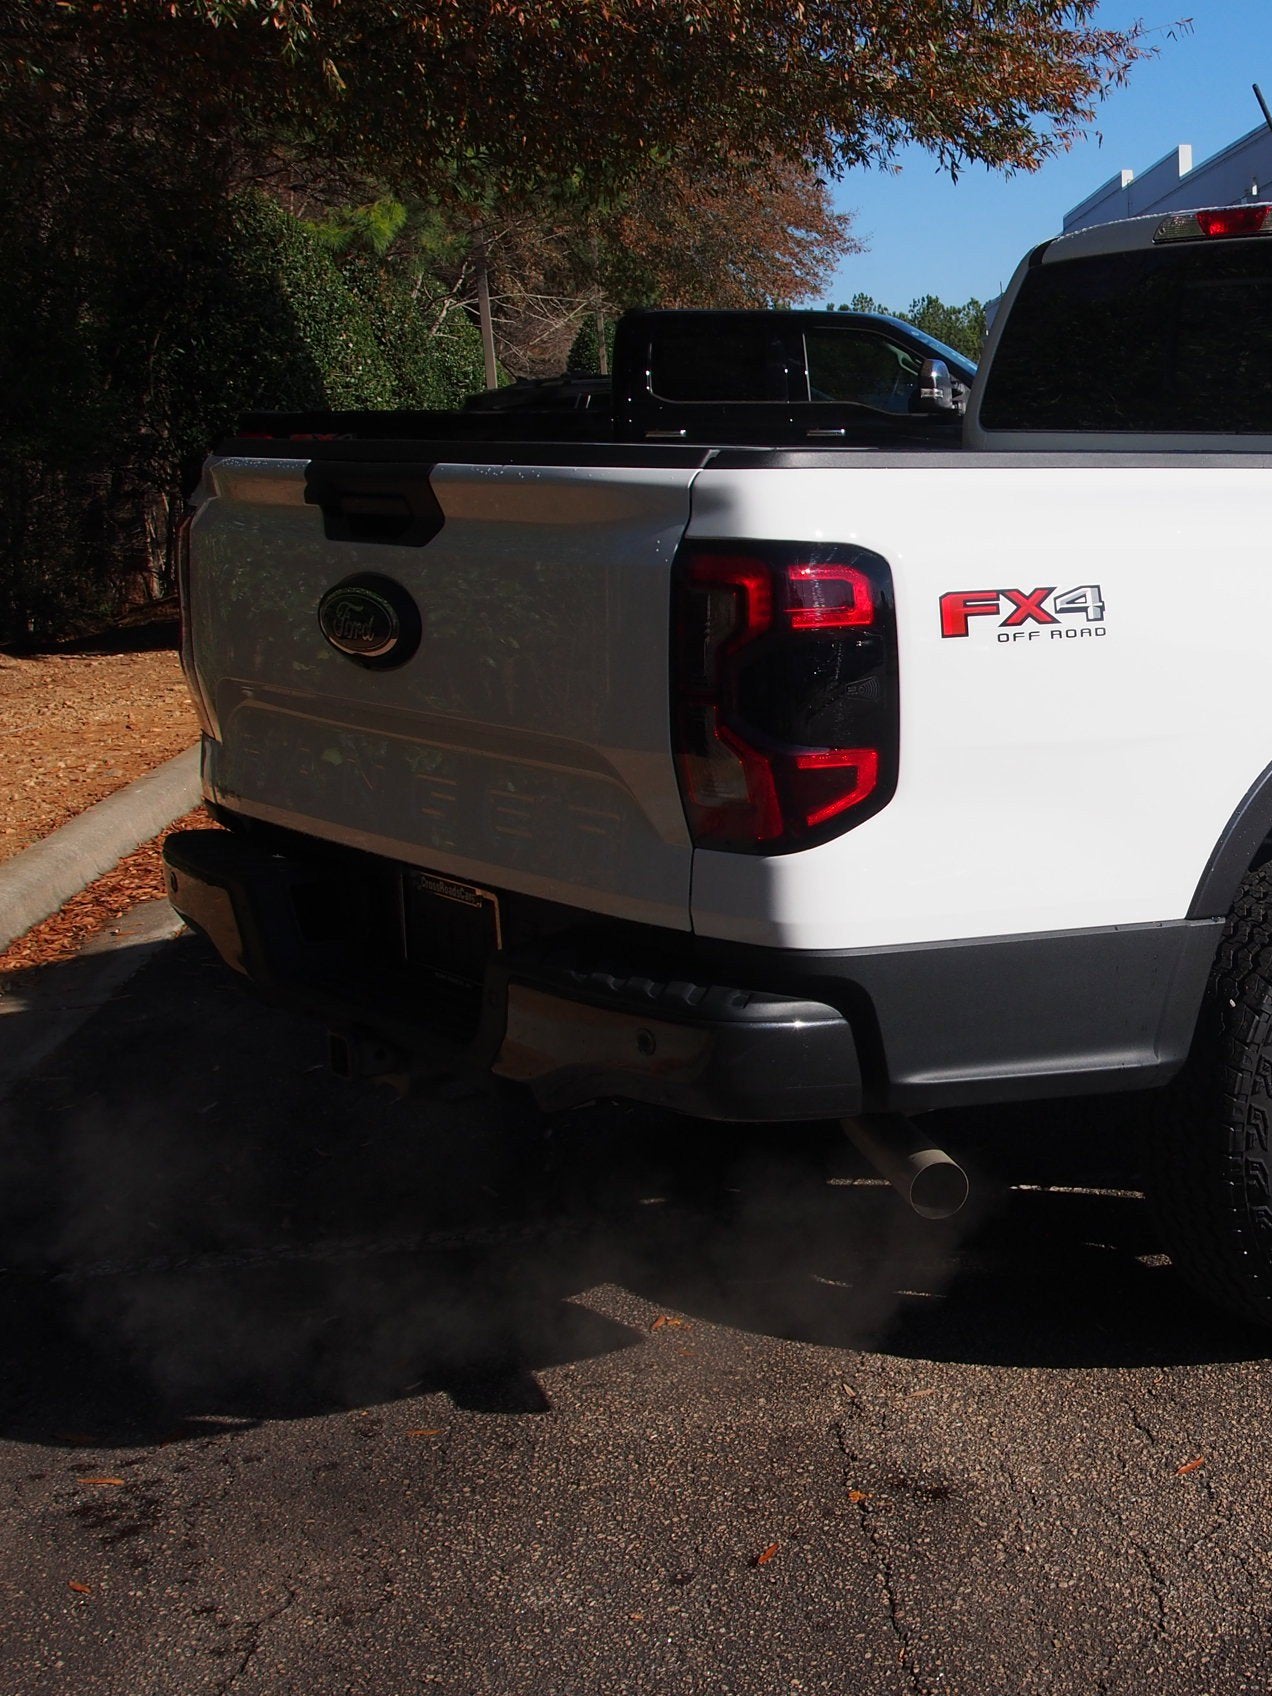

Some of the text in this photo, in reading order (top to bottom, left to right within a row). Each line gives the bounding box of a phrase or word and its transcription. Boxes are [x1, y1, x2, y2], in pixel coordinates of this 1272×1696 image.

[332, 600, 376, 642] Ford
[939, 584, 1106, 639] FX4
[997, 627, 1107, 643] OFF ROAD
